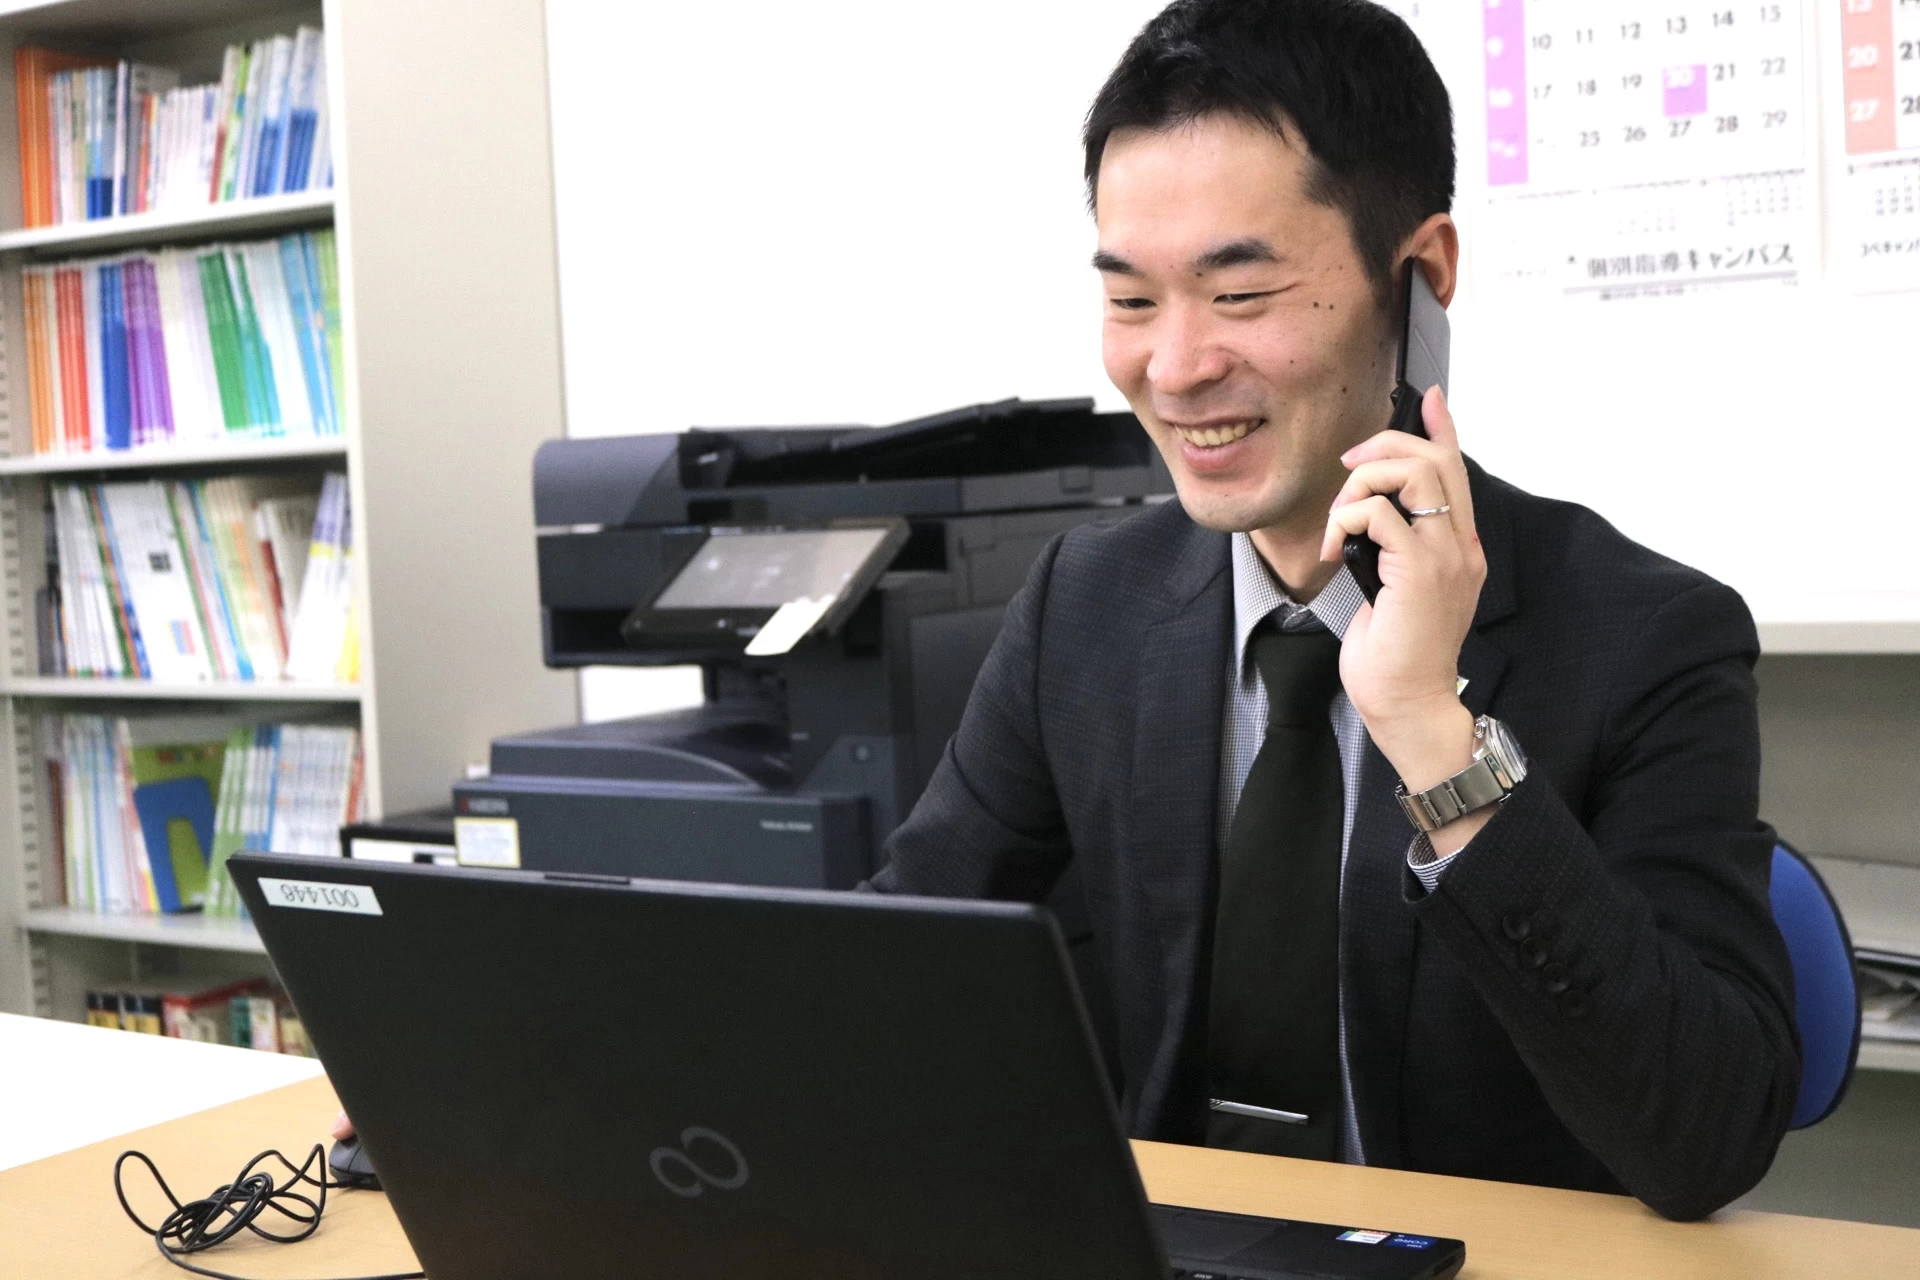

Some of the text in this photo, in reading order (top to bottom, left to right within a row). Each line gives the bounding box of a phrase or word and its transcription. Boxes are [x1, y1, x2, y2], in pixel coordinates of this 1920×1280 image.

[1532, 34, 1552, 50] 10
[1576, 29, 1593, 44] 11
[1620, 22, 1641, 40] 12
[1666, 16, 1687, 34] 13
[1713, 10, 1734, 27] 14
[1760, 5, 1781, 23] 15
[1848, 45, 1878, 68] 20
[1533, 84, 1552, 99] 17
[1577, 79, 1597, 96] 18
[1621, 74, 1642, 89] 19
[1713, 63, 1735, 81] 21
[1761, 57, 1785, 76] 22
[1579, 130, 1600, 147] 25
[1623, 126, 1647, 143] 26
[1668, 119, 1692, 138] 27
[1715, 115, 1739, 133] 28
[1763, 110, 1787, 128] 29
[1849, 99, 1880, 122] 27
